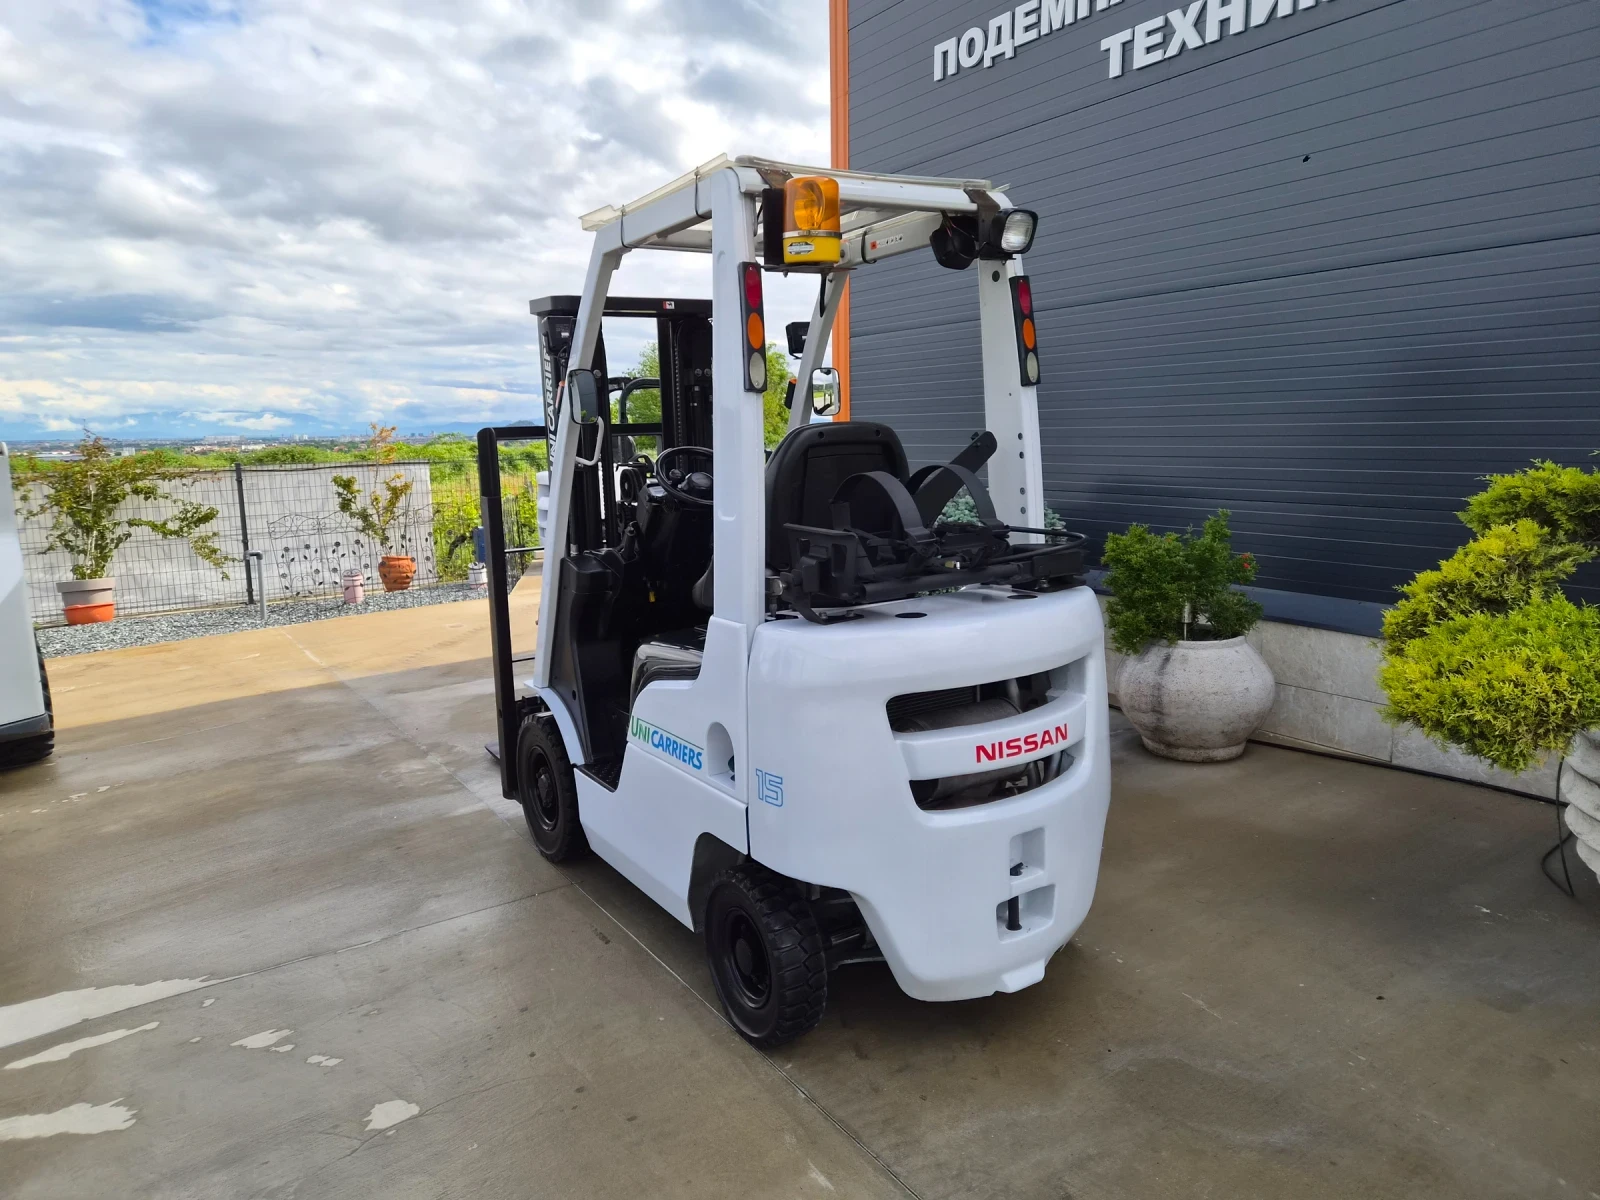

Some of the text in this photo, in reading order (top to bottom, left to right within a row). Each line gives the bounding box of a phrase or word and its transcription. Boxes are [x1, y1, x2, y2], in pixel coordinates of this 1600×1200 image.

[933, 0, 1123, 82] ПОДЕМ
[1100, 0, 1336, 79] ТЕХН
[975, 723, 1068, 764] NISSAN
[755, 768, 784, 808] 15
